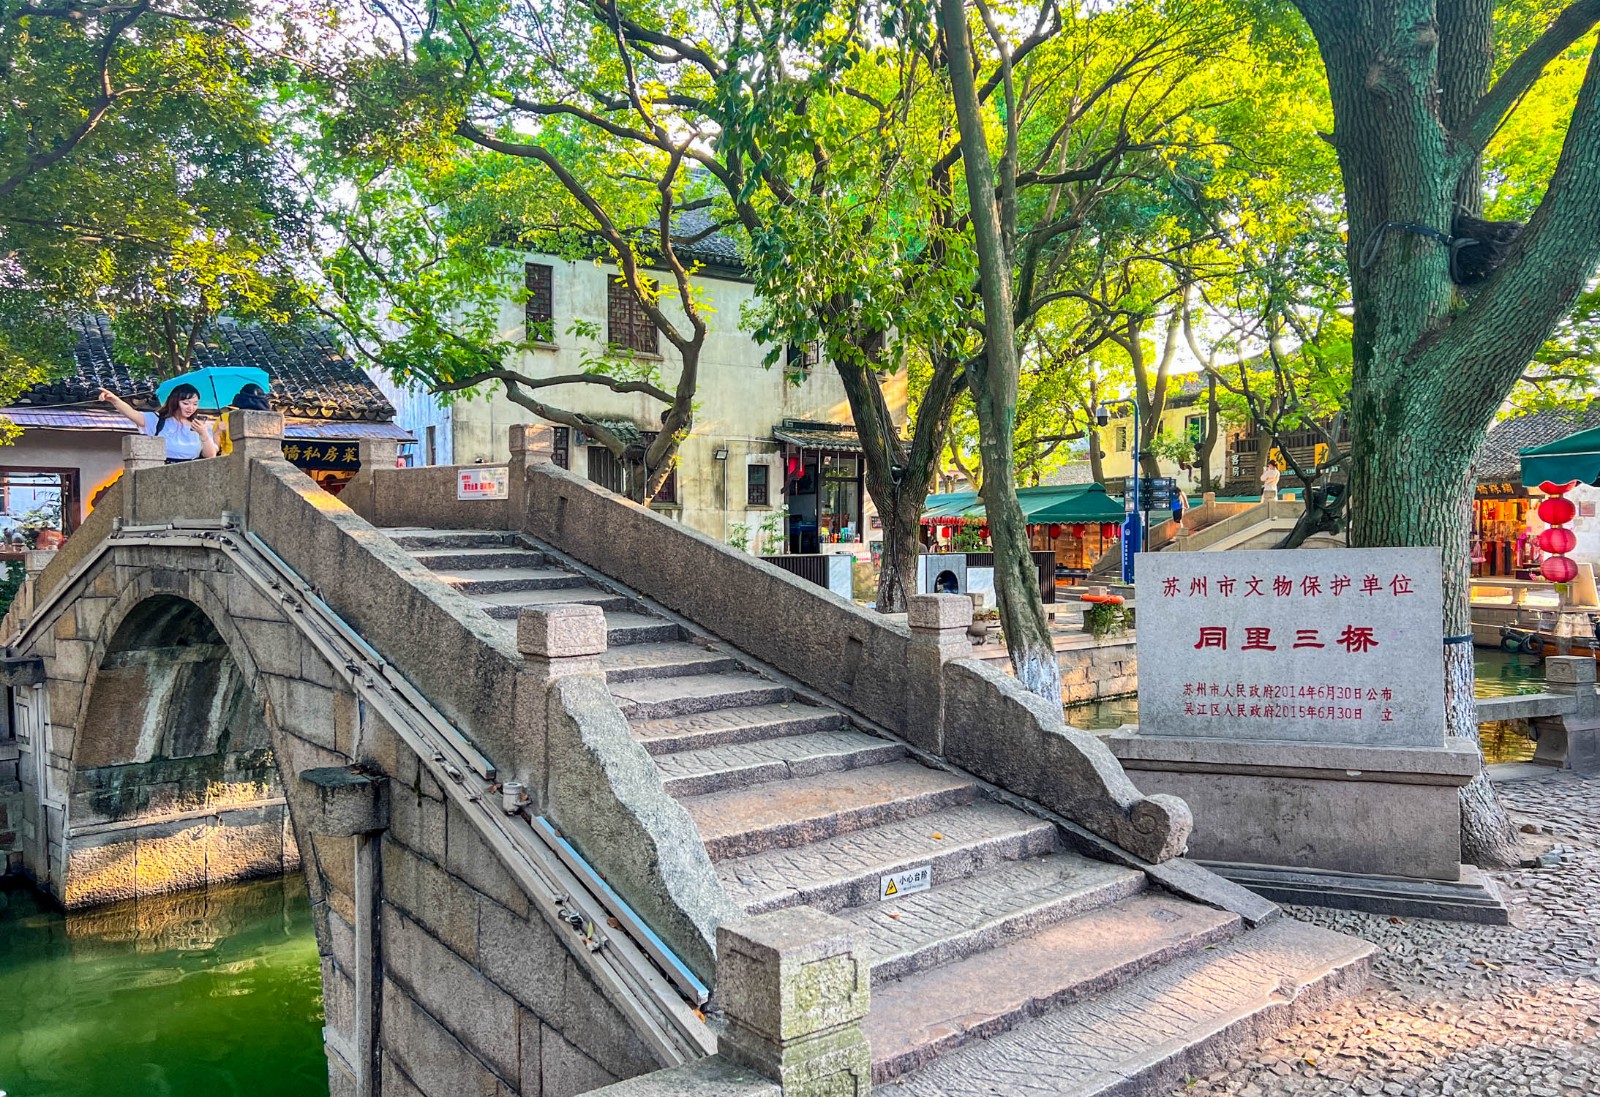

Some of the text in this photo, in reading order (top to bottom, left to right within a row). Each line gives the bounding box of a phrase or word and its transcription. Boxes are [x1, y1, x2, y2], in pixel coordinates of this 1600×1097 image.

[1161, 573, 1414, 598] 苏州市文物保护单位
[1193, 624, 1380, 654] 同里三桥
[1183, 701, 1394, 722] 吴江区人民政府2015年6月30日 立
[900, 870, 928, 885] 小心台阶
